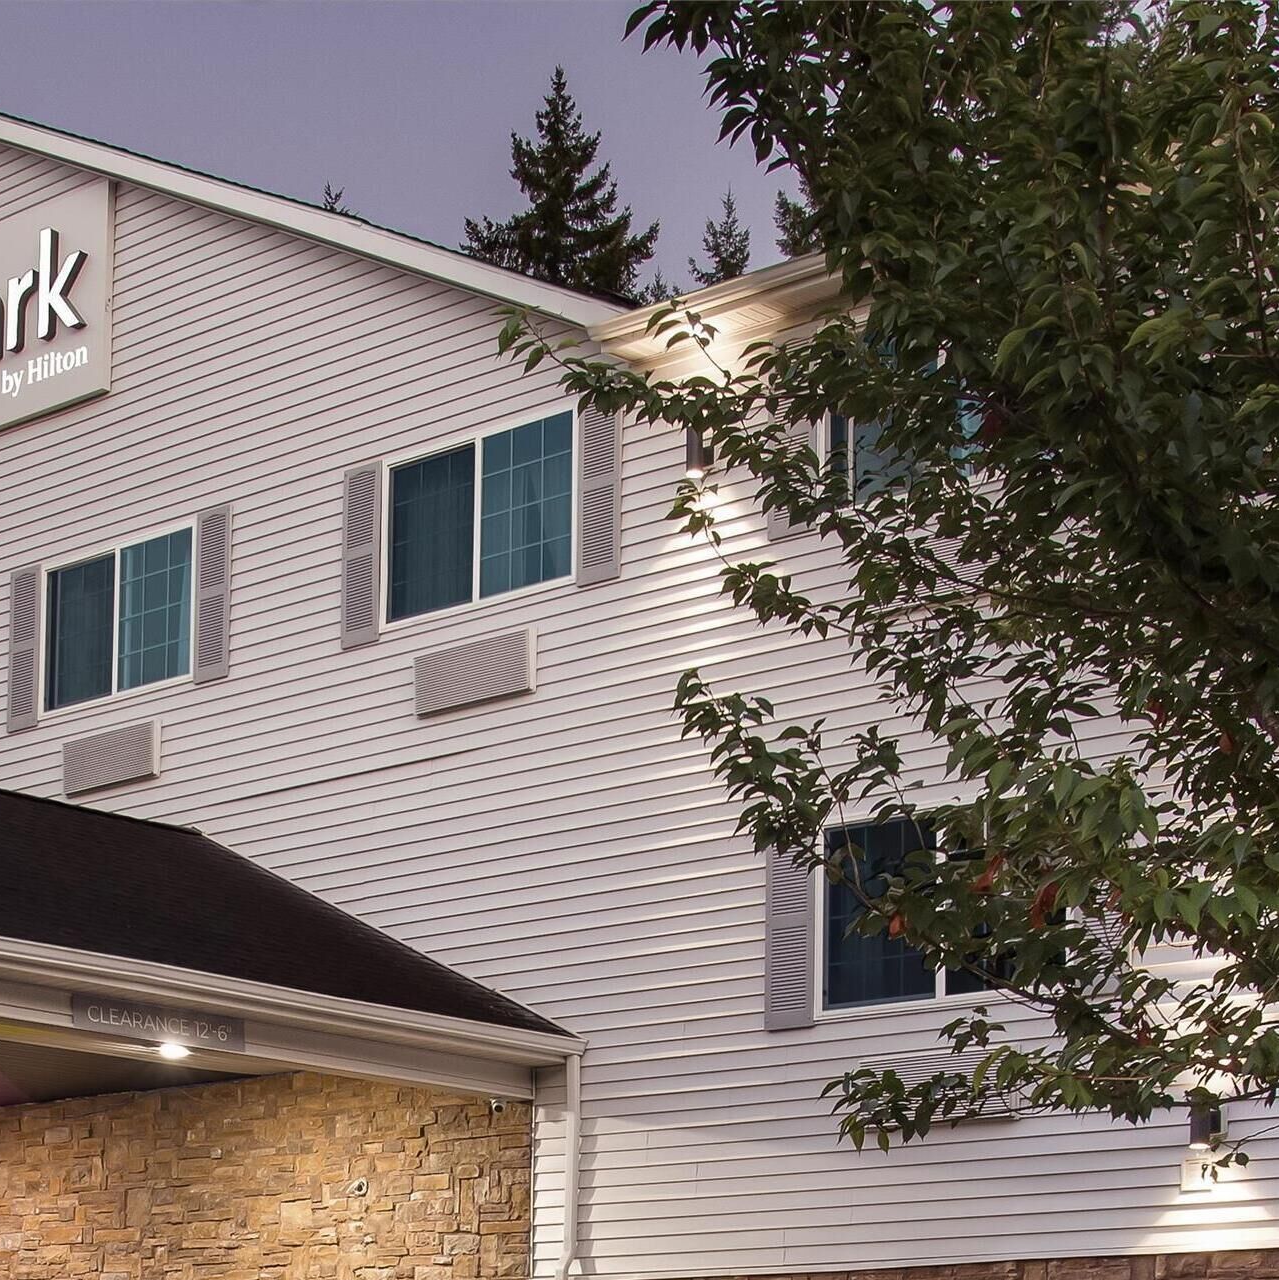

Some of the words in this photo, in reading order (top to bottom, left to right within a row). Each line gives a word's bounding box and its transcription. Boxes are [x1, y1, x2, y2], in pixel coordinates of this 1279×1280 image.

[1, 369, 25, 398] by
[27, 345, 89, 385] Hilton
[87, 1005, 191, 1037] CLEARANCE
[194, 1021, 232, 1042] 12'-6"
